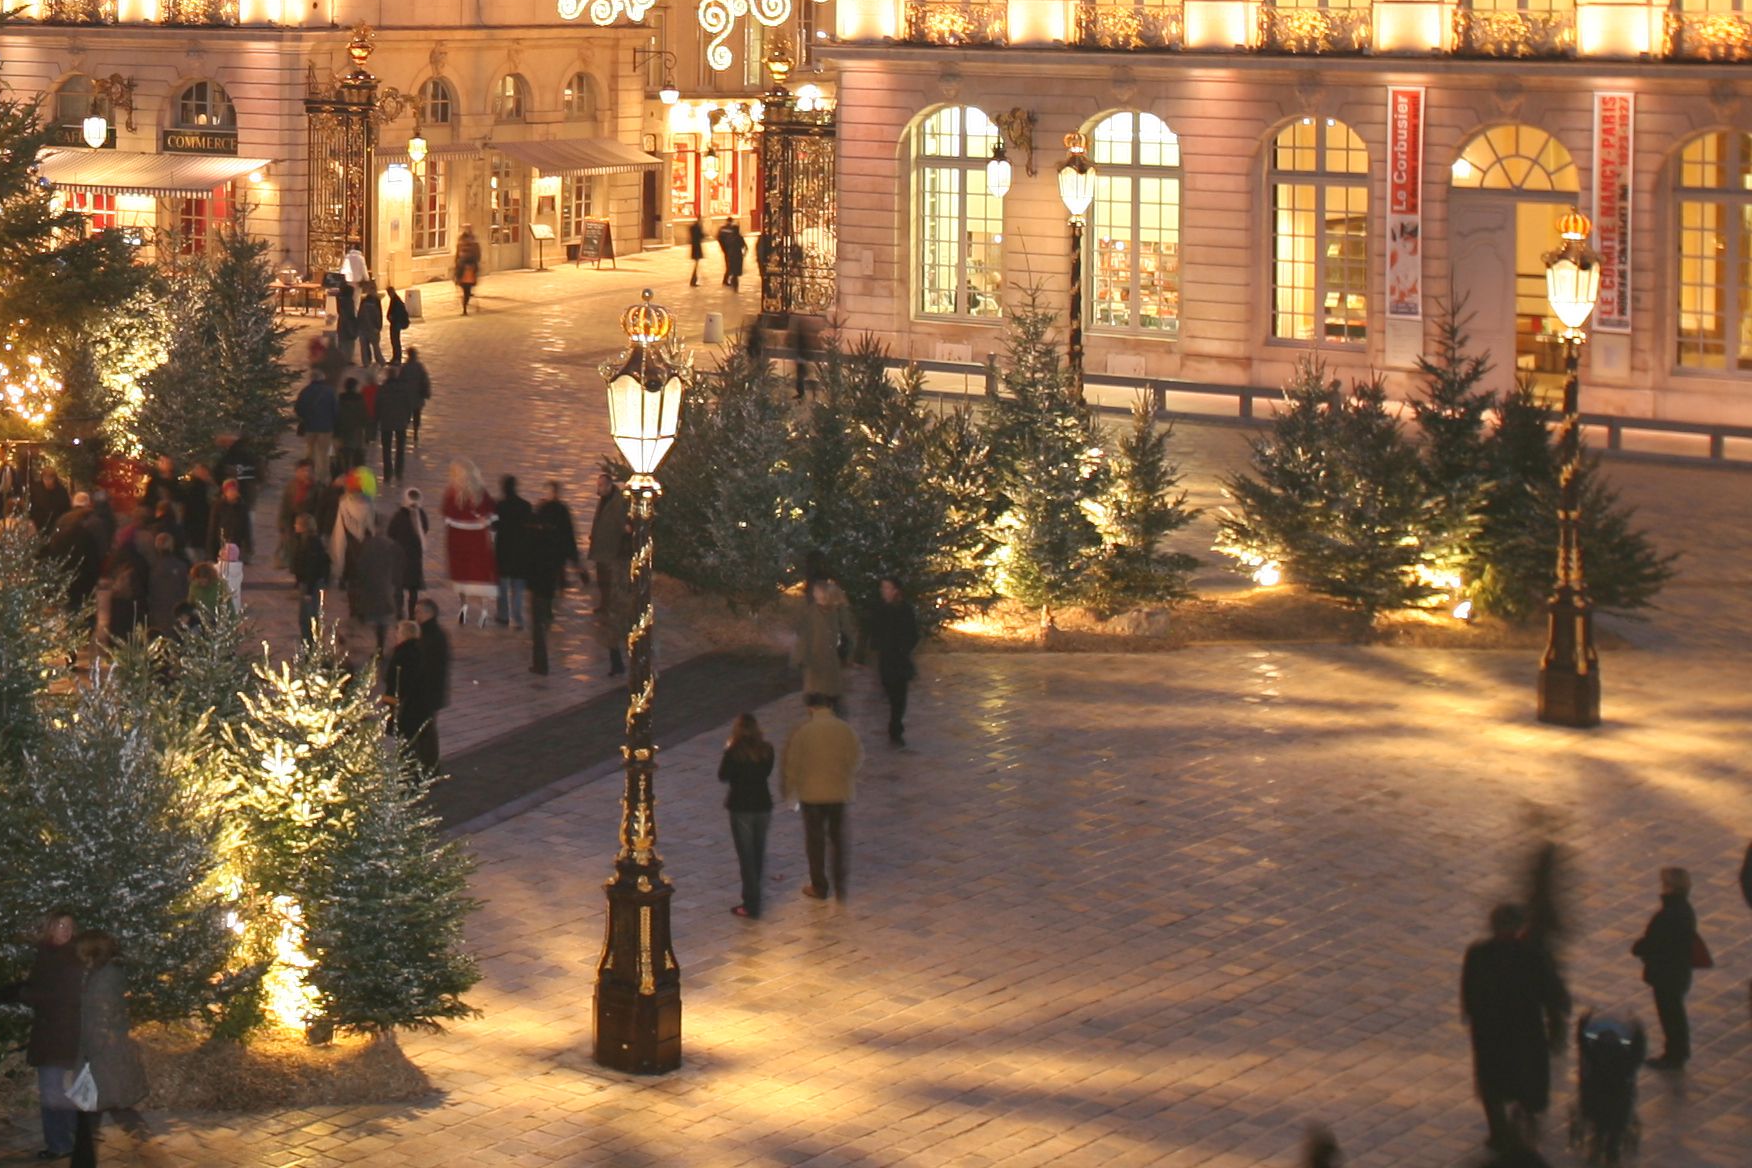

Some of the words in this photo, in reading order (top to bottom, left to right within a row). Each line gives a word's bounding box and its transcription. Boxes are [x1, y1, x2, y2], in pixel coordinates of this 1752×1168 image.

[167, 135, 236, 151] COMMERCE
[1393, 95, 1408, 184] Corbusier
[1393, 190, 1407, 211] Le
[1600, 297, 1615, 317] LE
